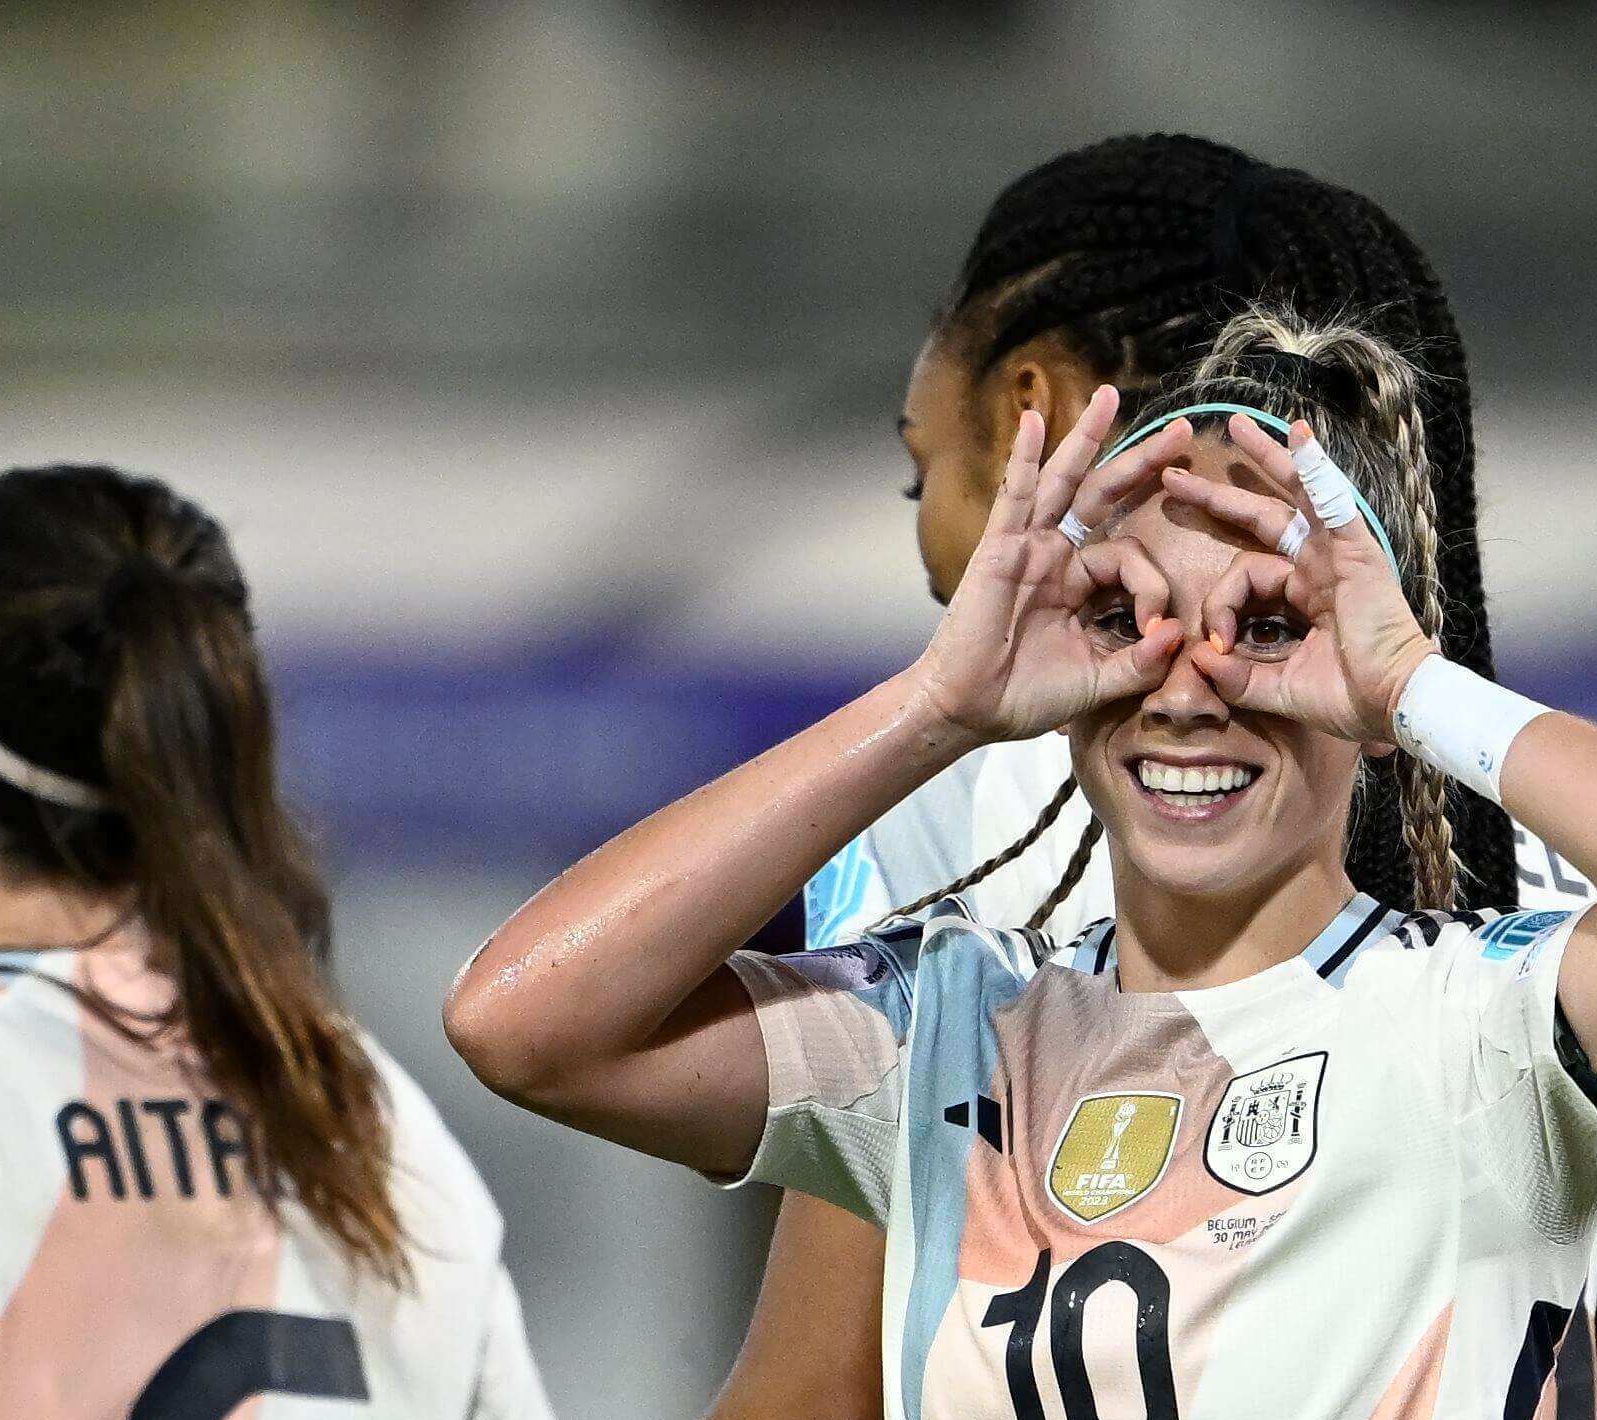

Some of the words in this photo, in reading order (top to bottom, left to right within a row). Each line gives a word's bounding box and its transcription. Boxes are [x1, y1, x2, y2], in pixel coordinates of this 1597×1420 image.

[1076, 1173, 1126, 1189] FIFA
[1207, 1217, 1257, 1231] BELGIUM
[1213, 1232, 1228, 1243] 30
